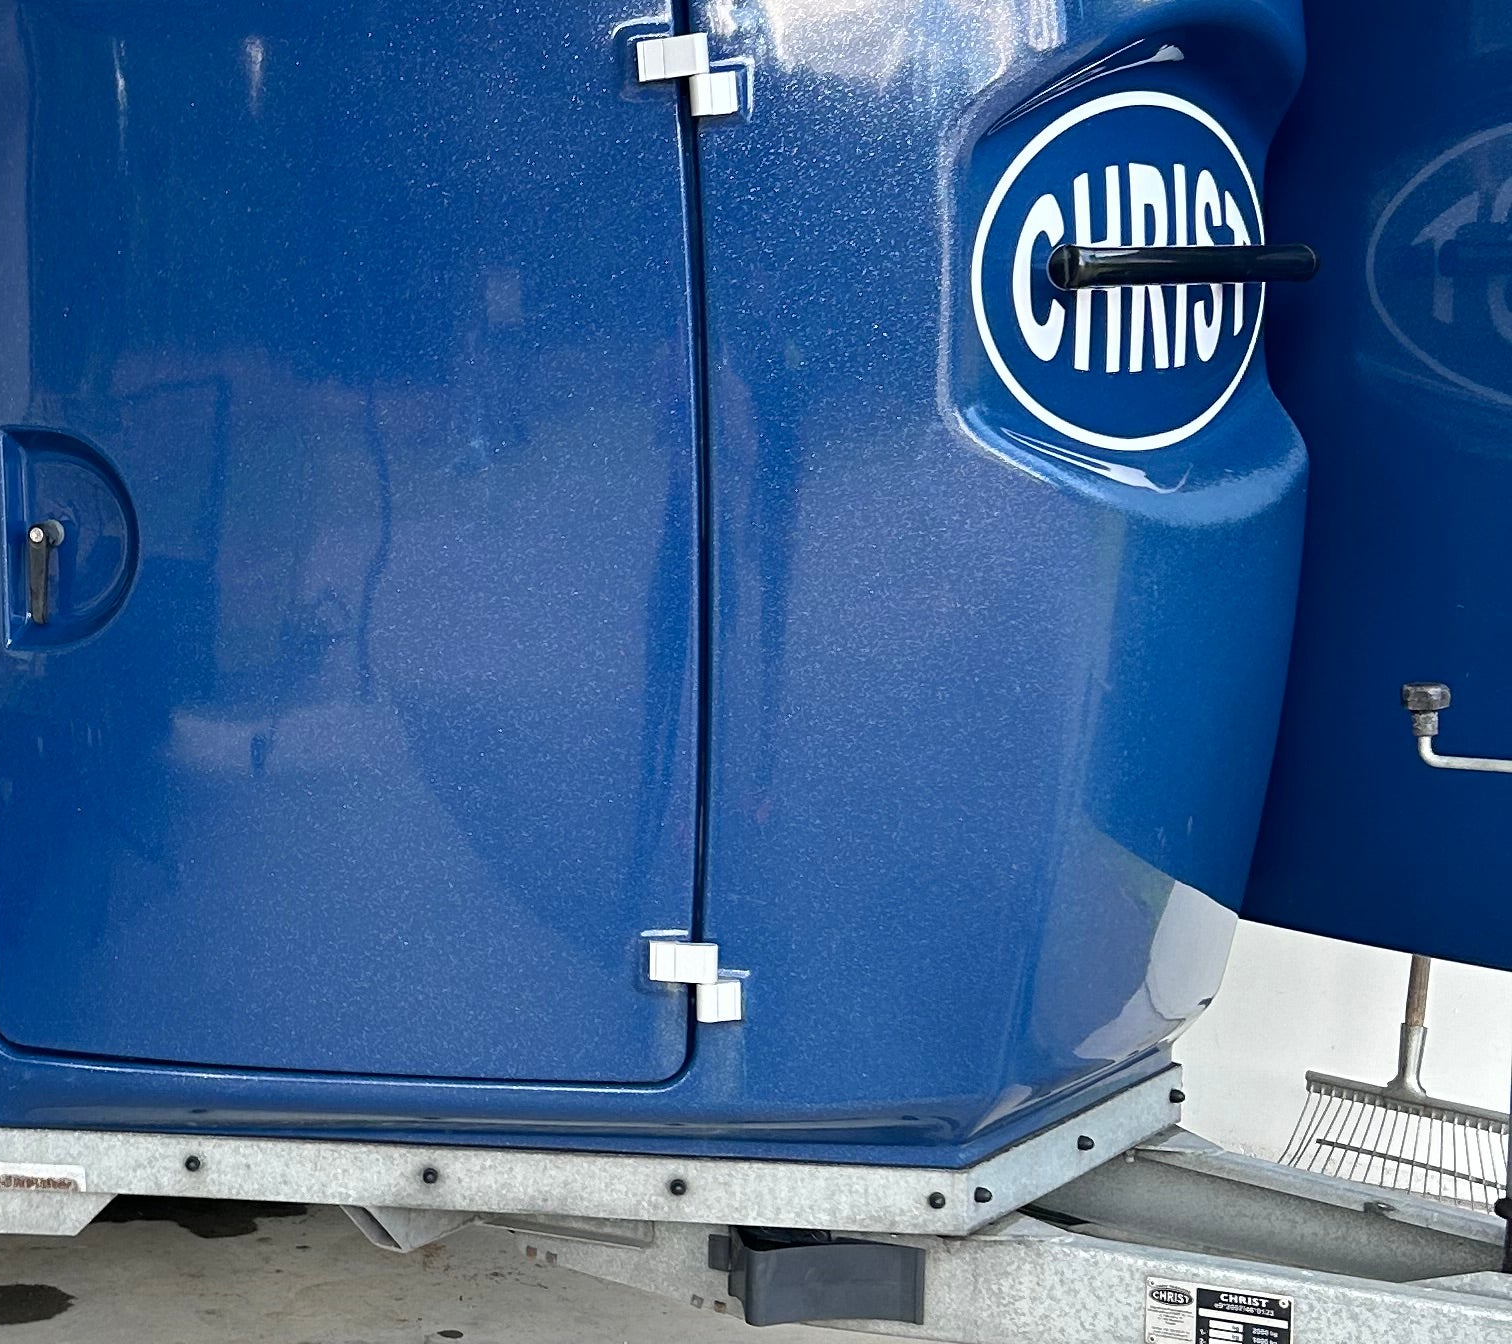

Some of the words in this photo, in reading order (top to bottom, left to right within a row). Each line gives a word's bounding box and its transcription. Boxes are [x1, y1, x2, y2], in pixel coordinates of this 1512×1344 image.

[1012, 162, 1252, 373] CHRIST
[1152, 1290, 1190, 1304] CHRIST
[1219, 1293, 1269, 1308] CHRIST
